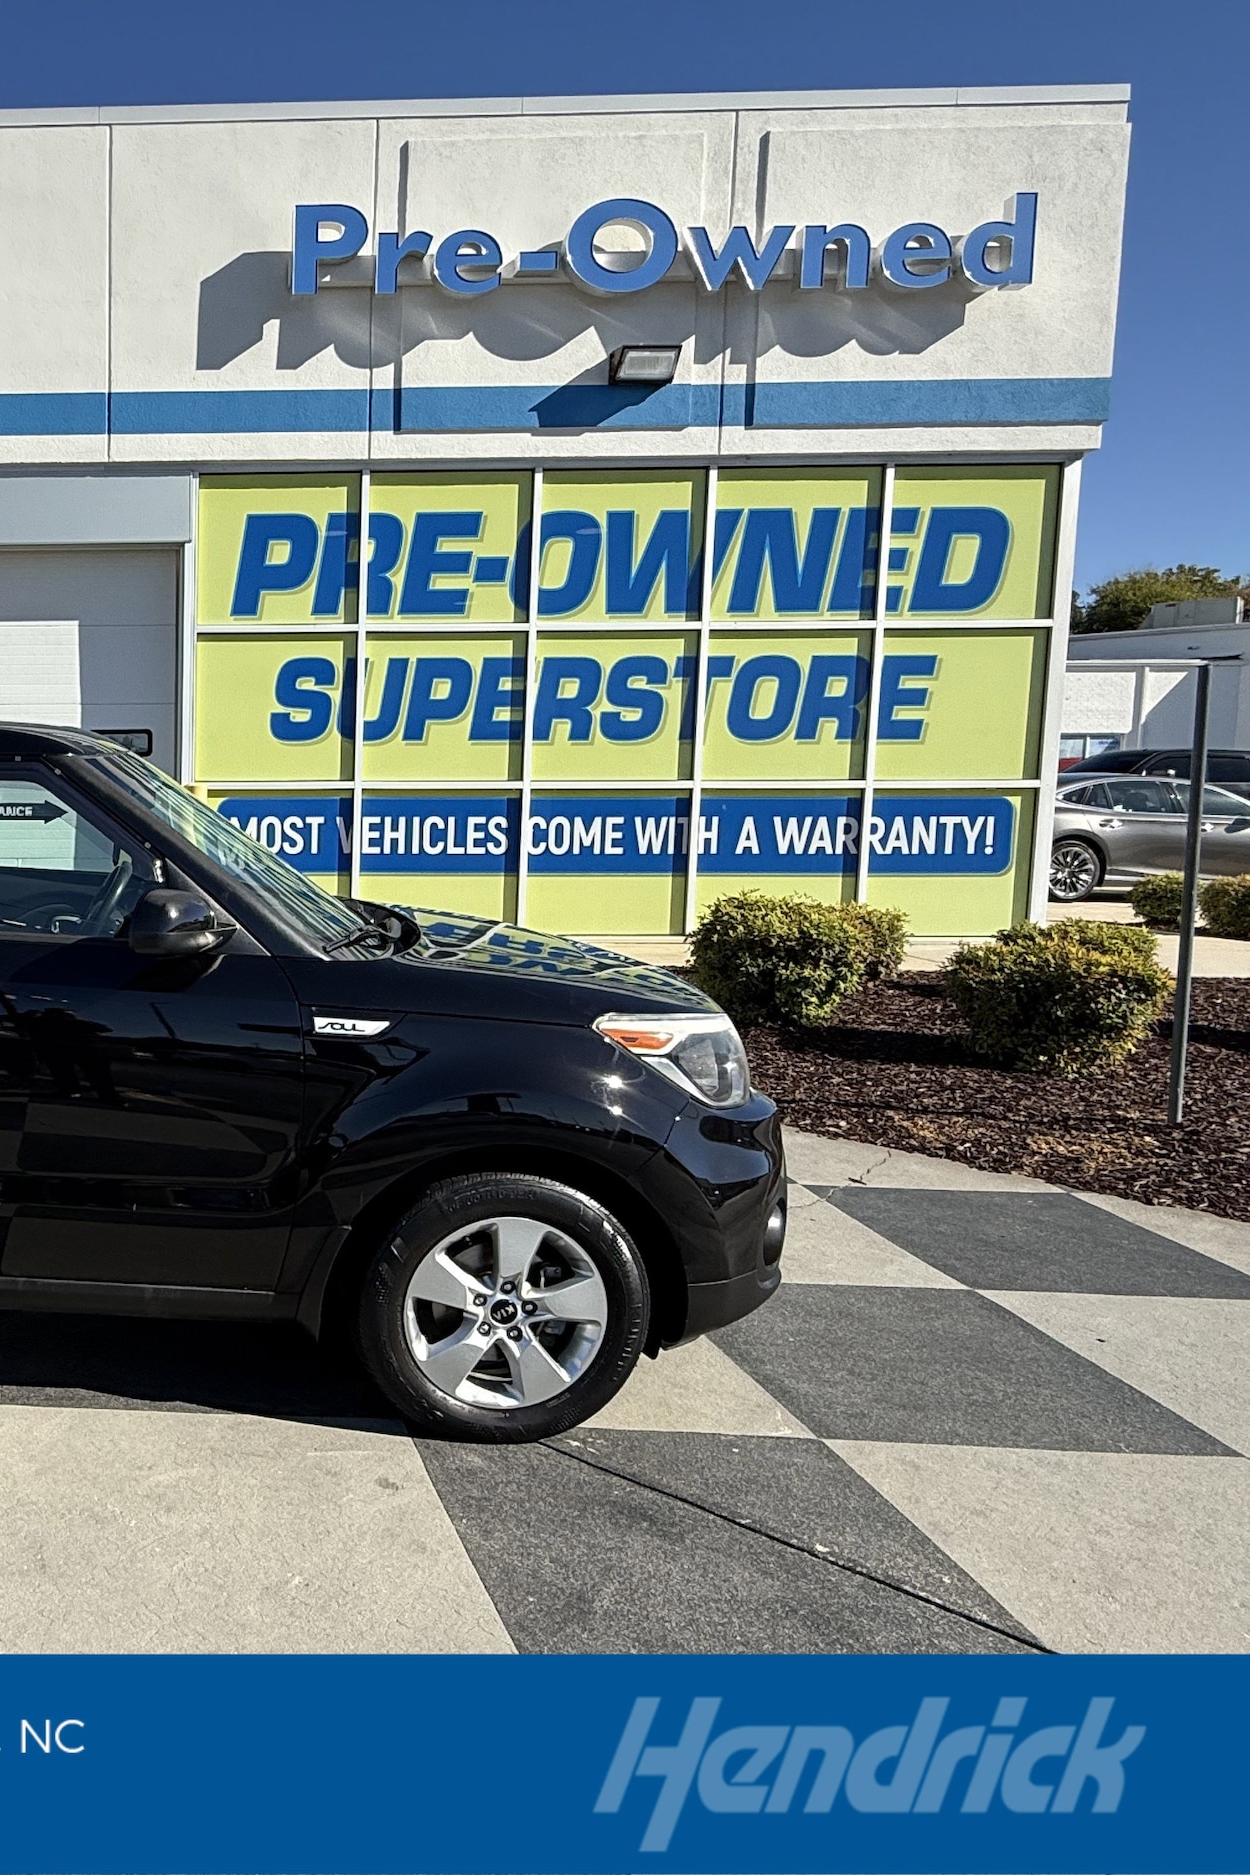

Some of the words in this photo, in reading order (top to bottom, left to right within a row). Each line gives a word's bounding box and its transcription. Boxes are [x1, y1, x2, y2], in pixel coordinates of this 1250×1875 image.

[293, 192, 1038, 297] Pre-Owned
[230, 507, 1011, 617] PRE-OWNED
[269, 655, 940, 743] SUPERSTORE
[526, 814, 624, 855] COME
[735, 815, 760, 855] A
[773, 814, 996, 856] WARRANTY!
[493, 1304, 515, 1320] KIA
